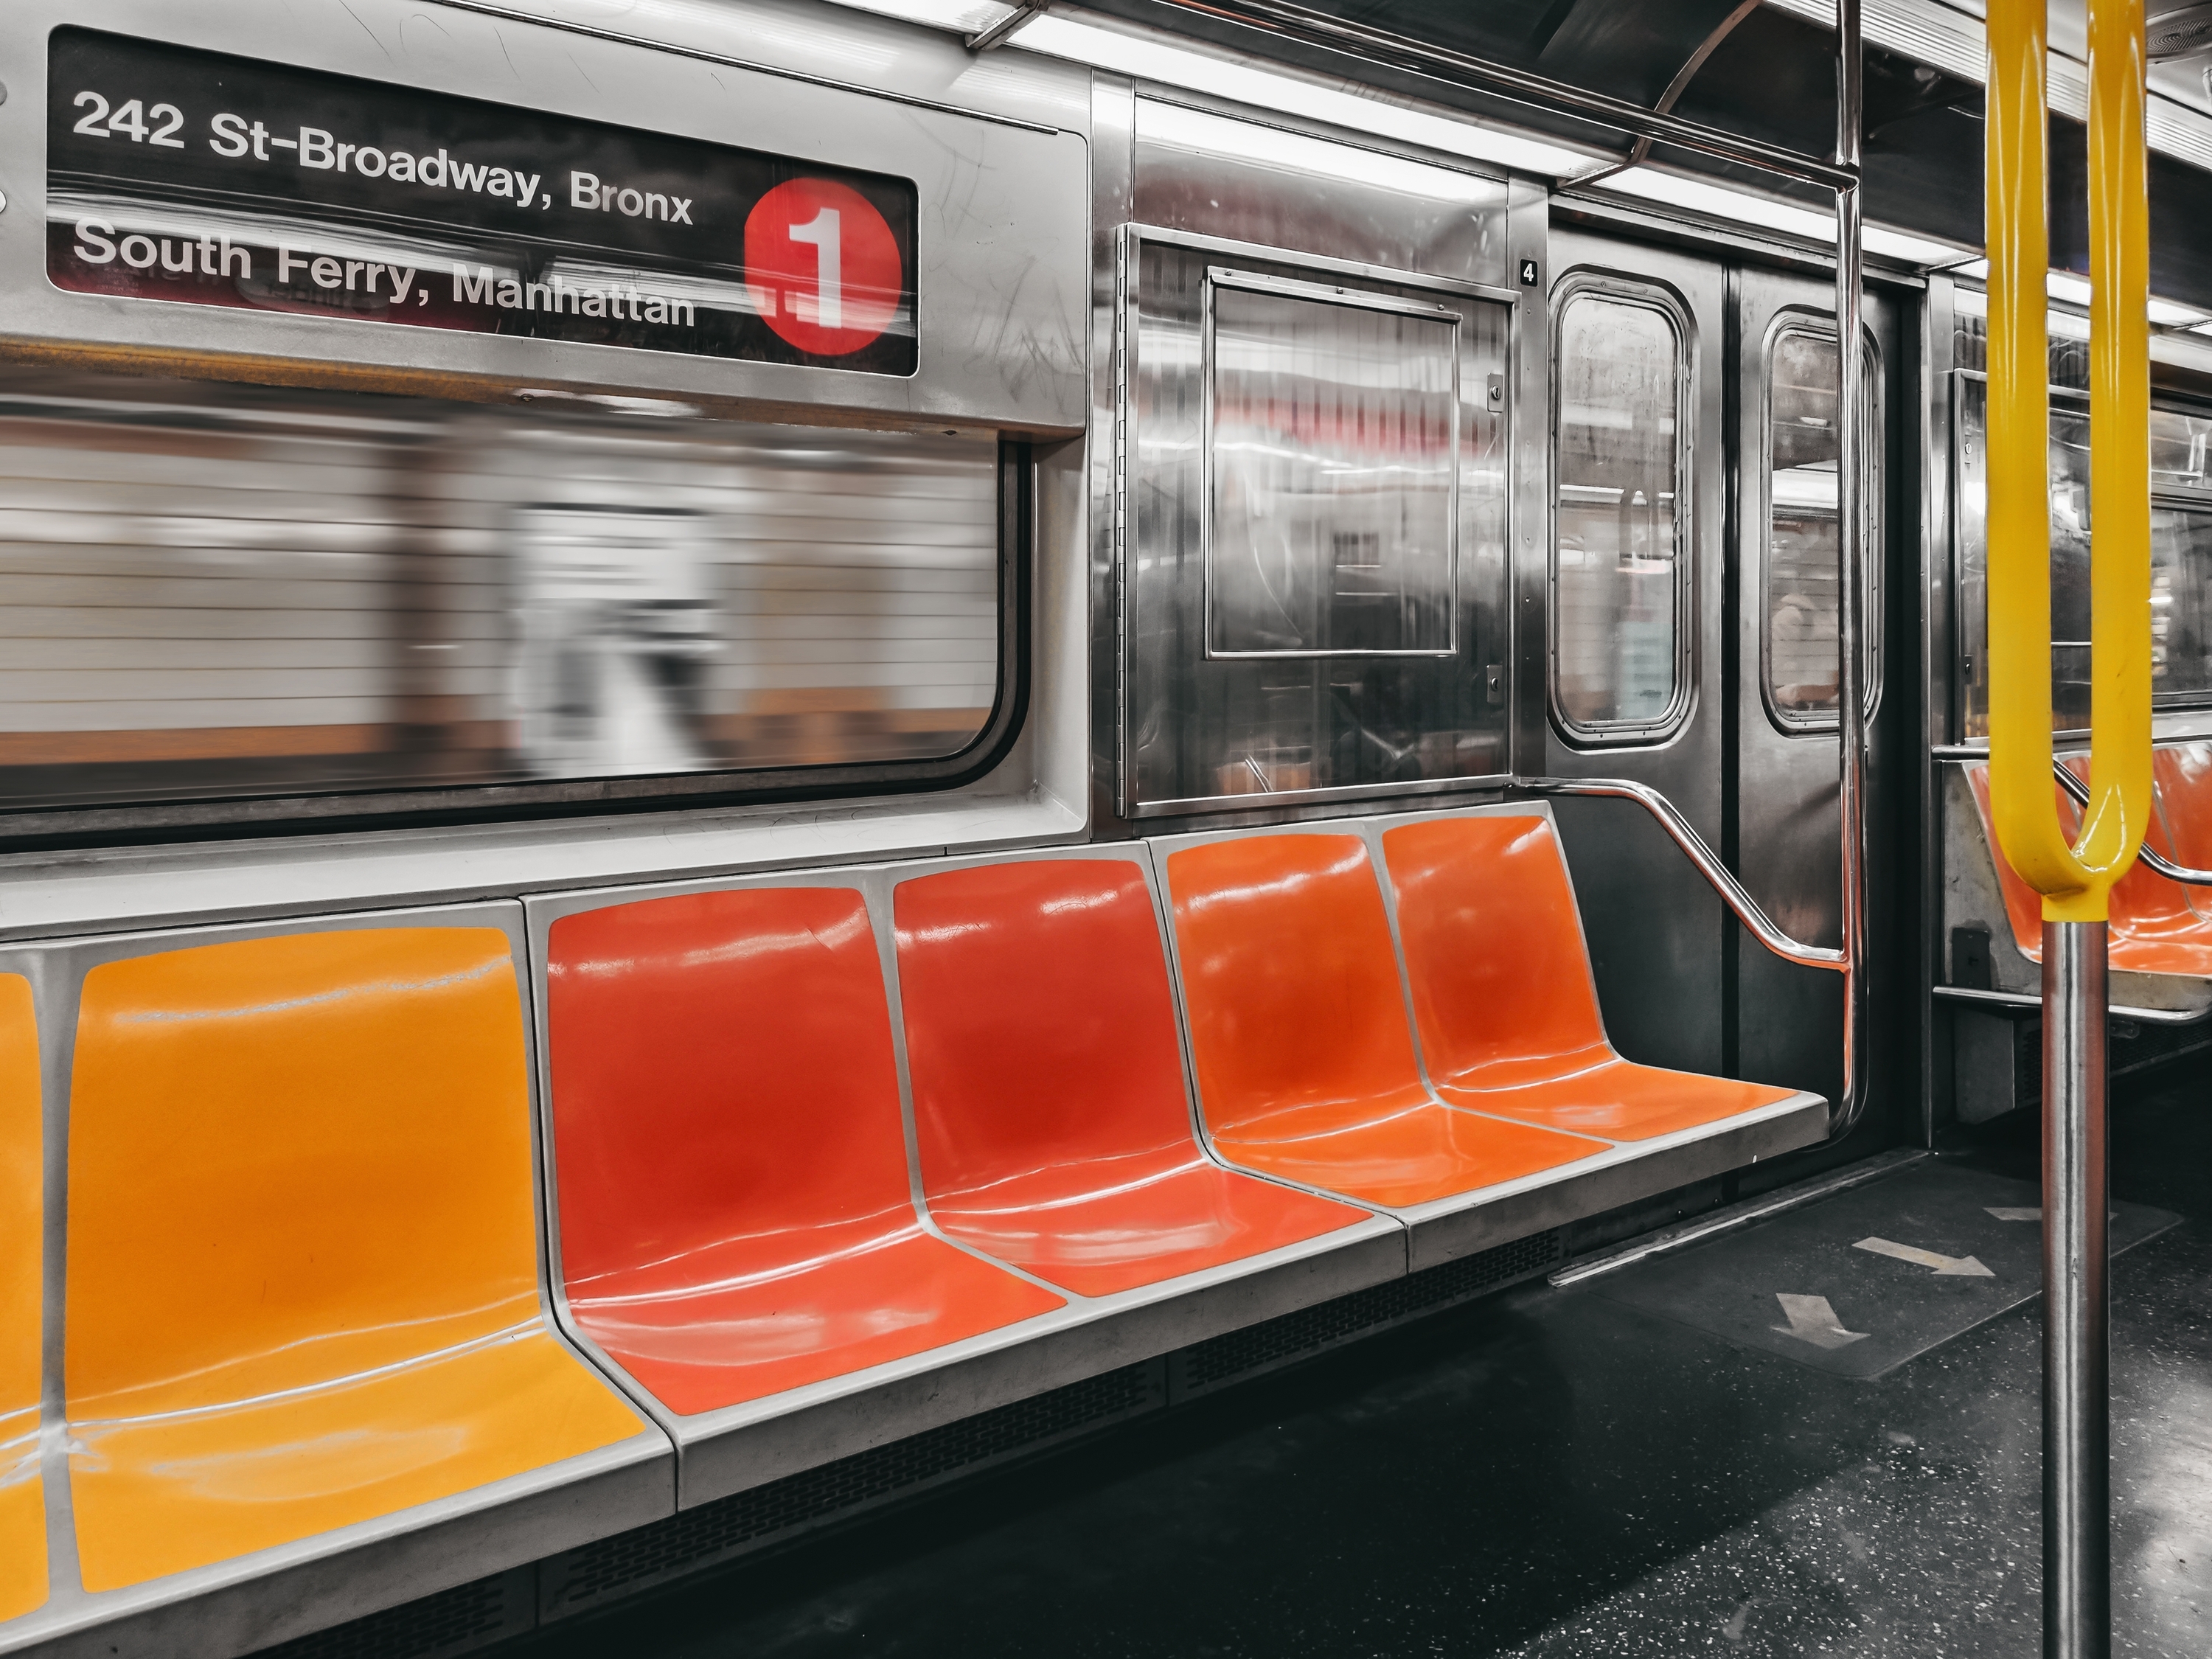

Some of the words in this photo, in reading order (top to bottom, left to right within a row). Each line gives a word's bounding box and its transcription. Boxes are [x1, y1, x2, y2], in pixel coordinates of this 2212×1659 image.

[73, 91, 185, 150] 242
[570, 170, 694, 226] Bronx
[73, 216, 252, 279] South
[277, 240, 430, 307] Ferry,
[452, 263, 695, 327] Manhattan
[788, 206, 842, 329] 1
[1523, 263, 1534, 282] 4
